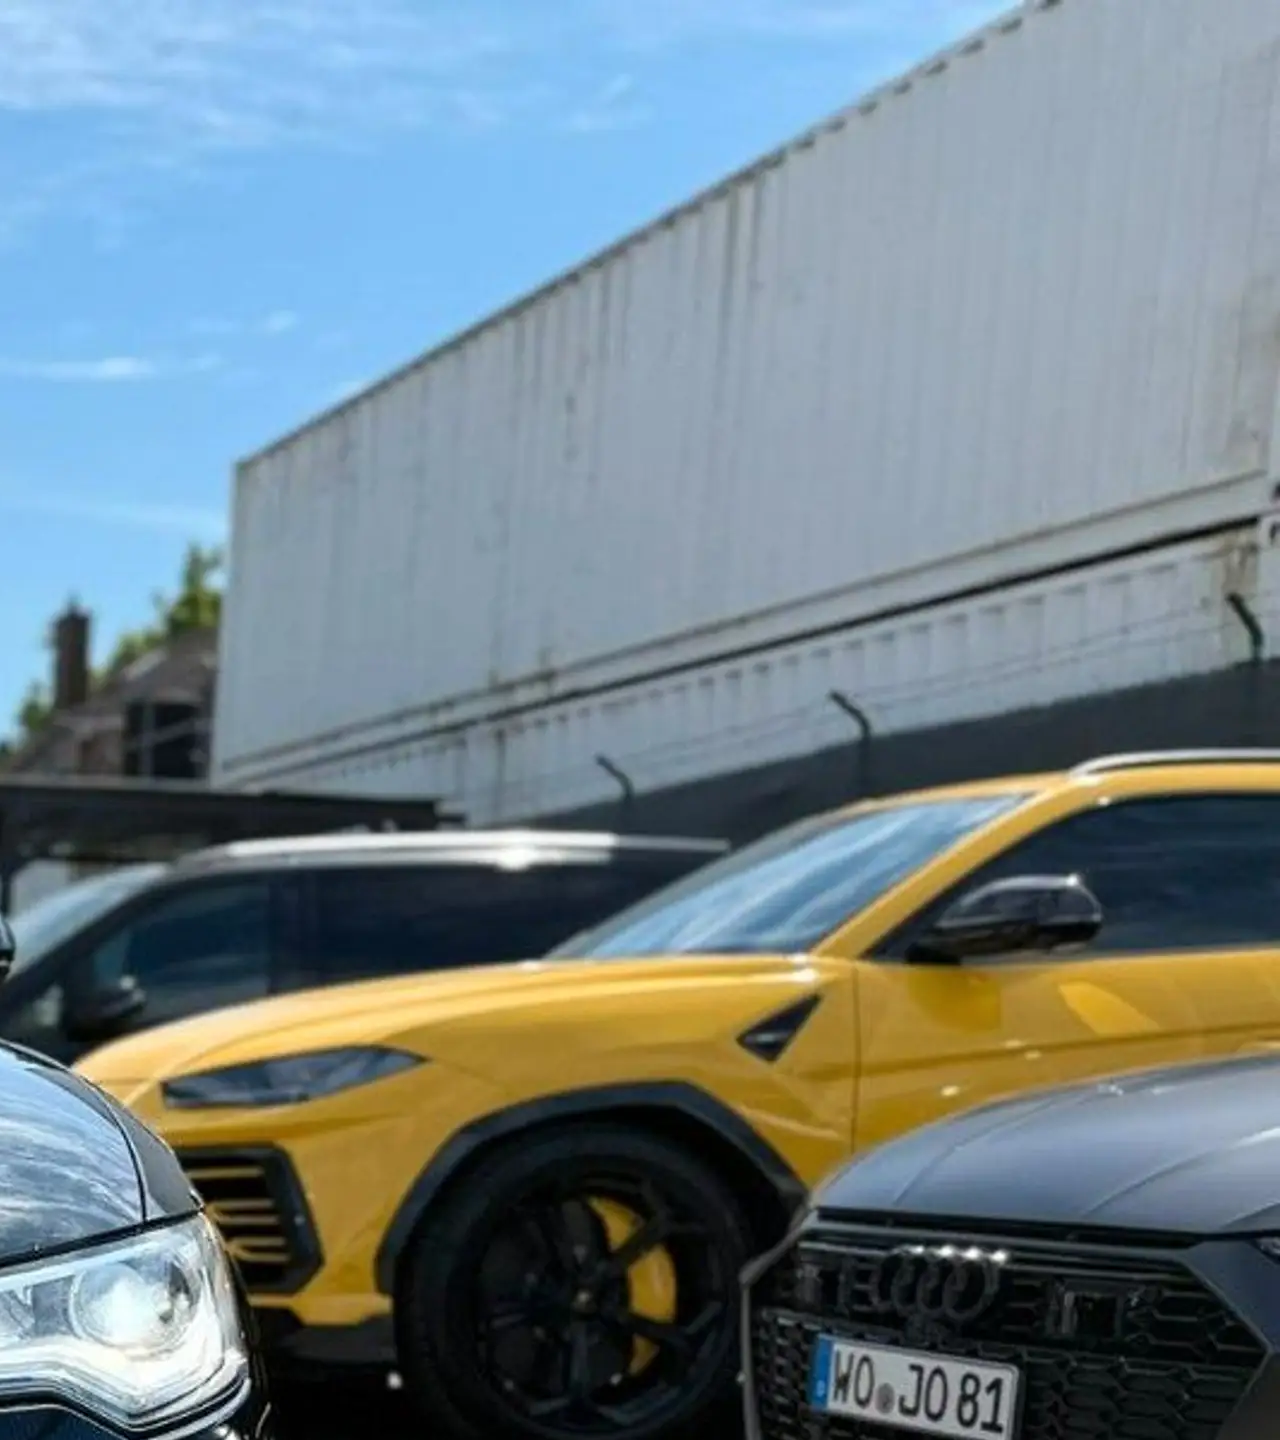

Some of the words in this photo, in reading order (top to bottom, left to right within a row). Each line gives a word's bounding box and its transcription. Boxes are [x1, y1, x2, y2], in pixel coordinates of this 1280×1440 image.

[833, 1350, 875, 1409] WO
[897, 1363, 949, 1423] JO
[956, 1372, 1005, 1434] 81
